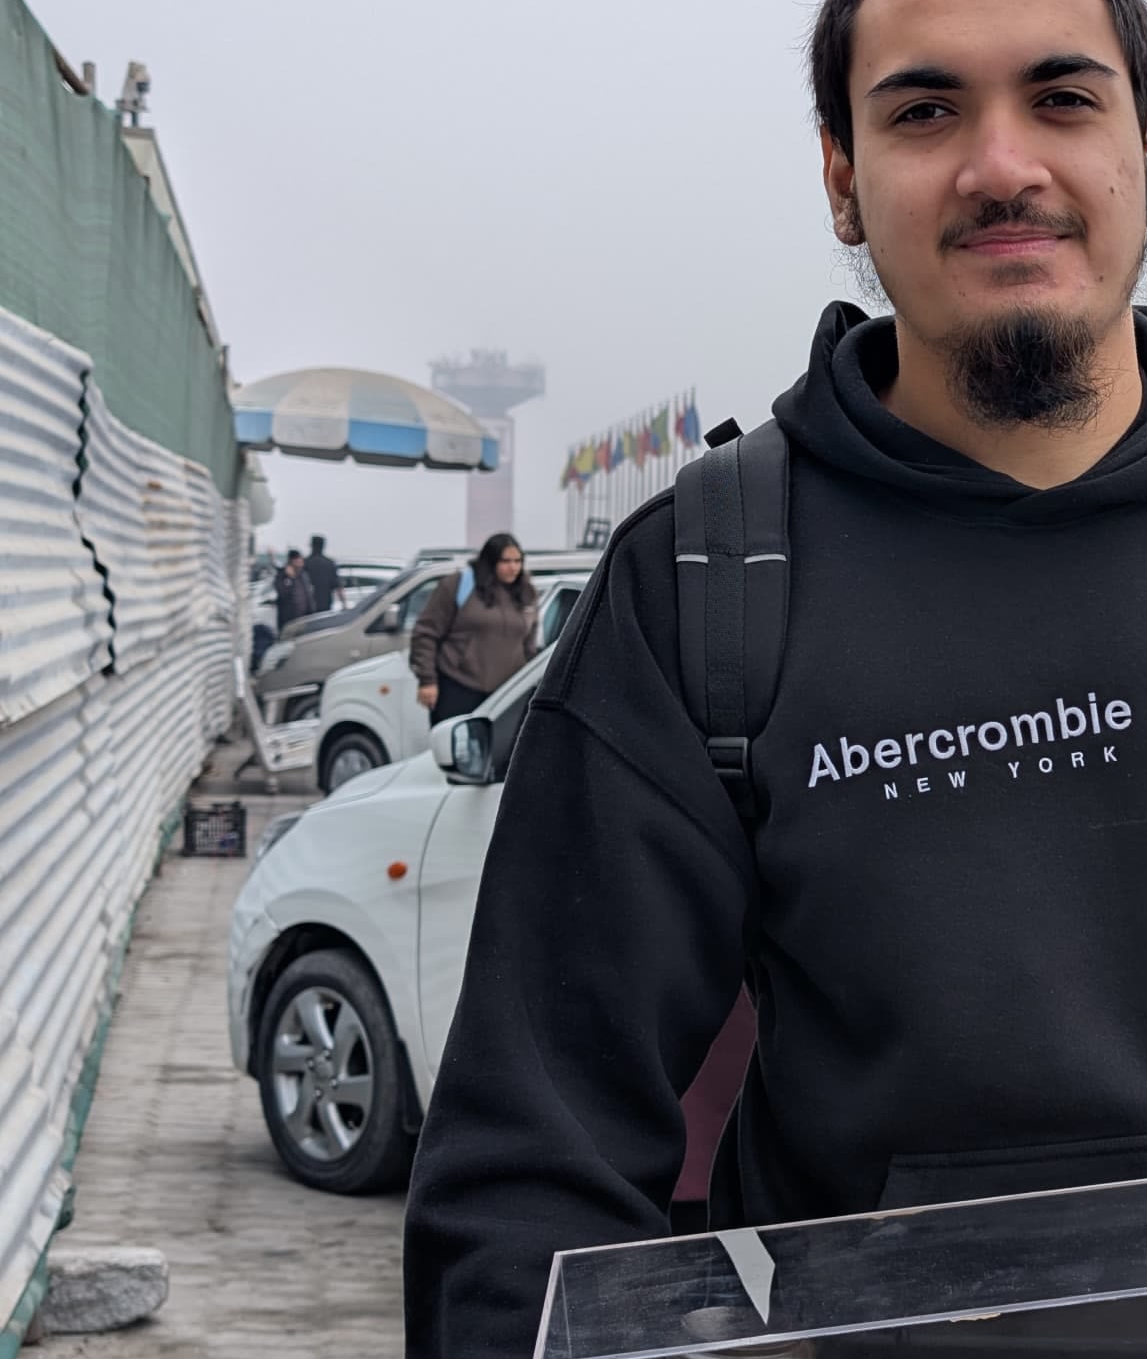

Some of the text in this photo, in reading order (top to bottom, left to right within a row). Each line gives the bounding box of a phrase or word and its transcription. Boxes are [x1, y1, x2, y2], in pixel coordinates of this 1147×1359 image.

[807, 692, 1132, 788] Abercrombie
[883, 770, 966, 800] NEW
[1007, 745, 1119, 779] YORK
